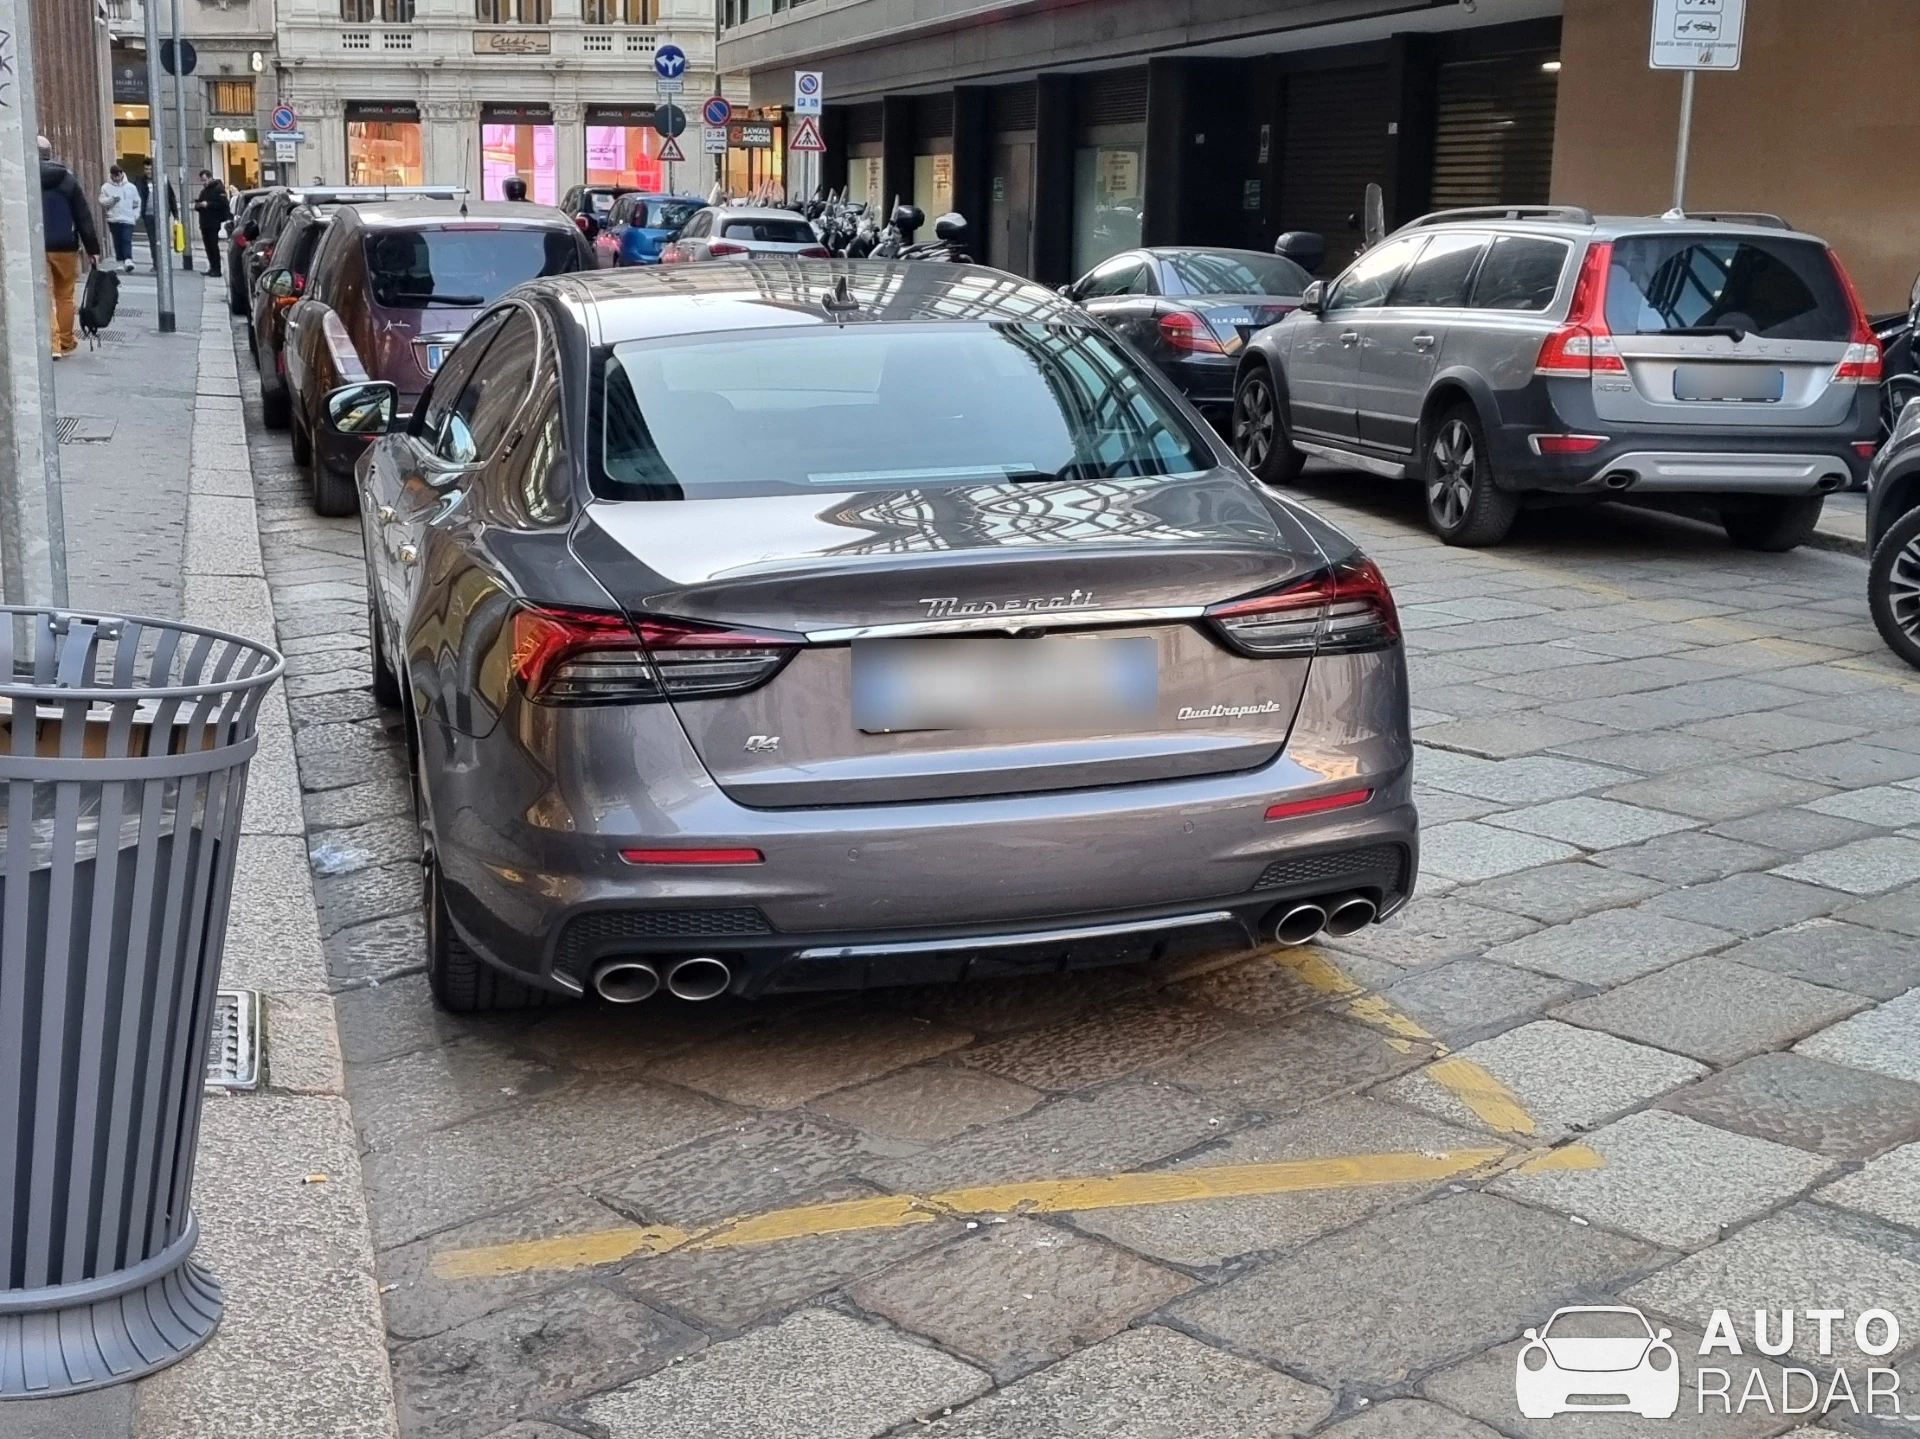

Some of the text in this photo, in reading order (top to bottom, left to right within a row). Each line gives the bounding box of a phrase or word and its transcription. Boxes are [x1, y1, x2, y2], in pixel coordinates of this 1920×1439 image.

[743, 126, 770, 134] SAWAYA
[742, 134, 771, 142] MORONI
[1595, 383, 1632, 393] XC70
[919, 589, 1101, 618] Maserati
[1177, 700, 1280, 720] Quattroporte
